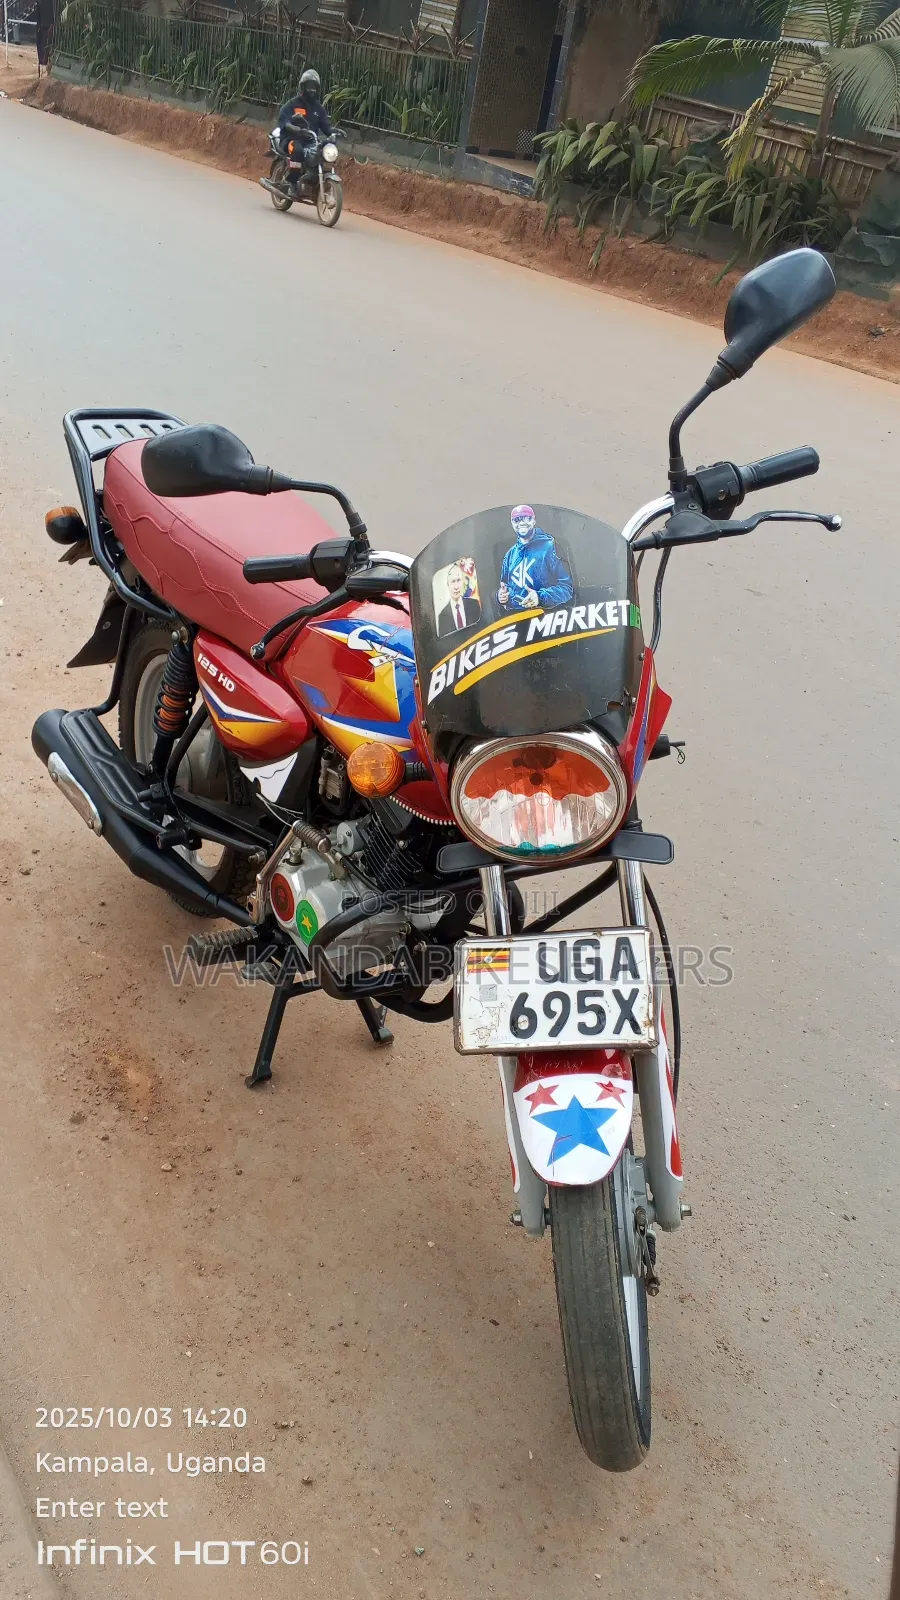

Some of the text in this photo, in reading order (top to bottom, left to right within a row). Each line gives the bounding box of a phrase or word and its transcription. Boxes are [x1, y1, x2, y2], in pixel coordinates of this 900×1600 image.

[197, 653, 236, 692] 125 HD
[428, 624, 518, 705] BIKES
[526, 600, 630, 642] MARKET
[538, 937, 640, 983] UGA
[509, 988, 642, 1039] 695X
